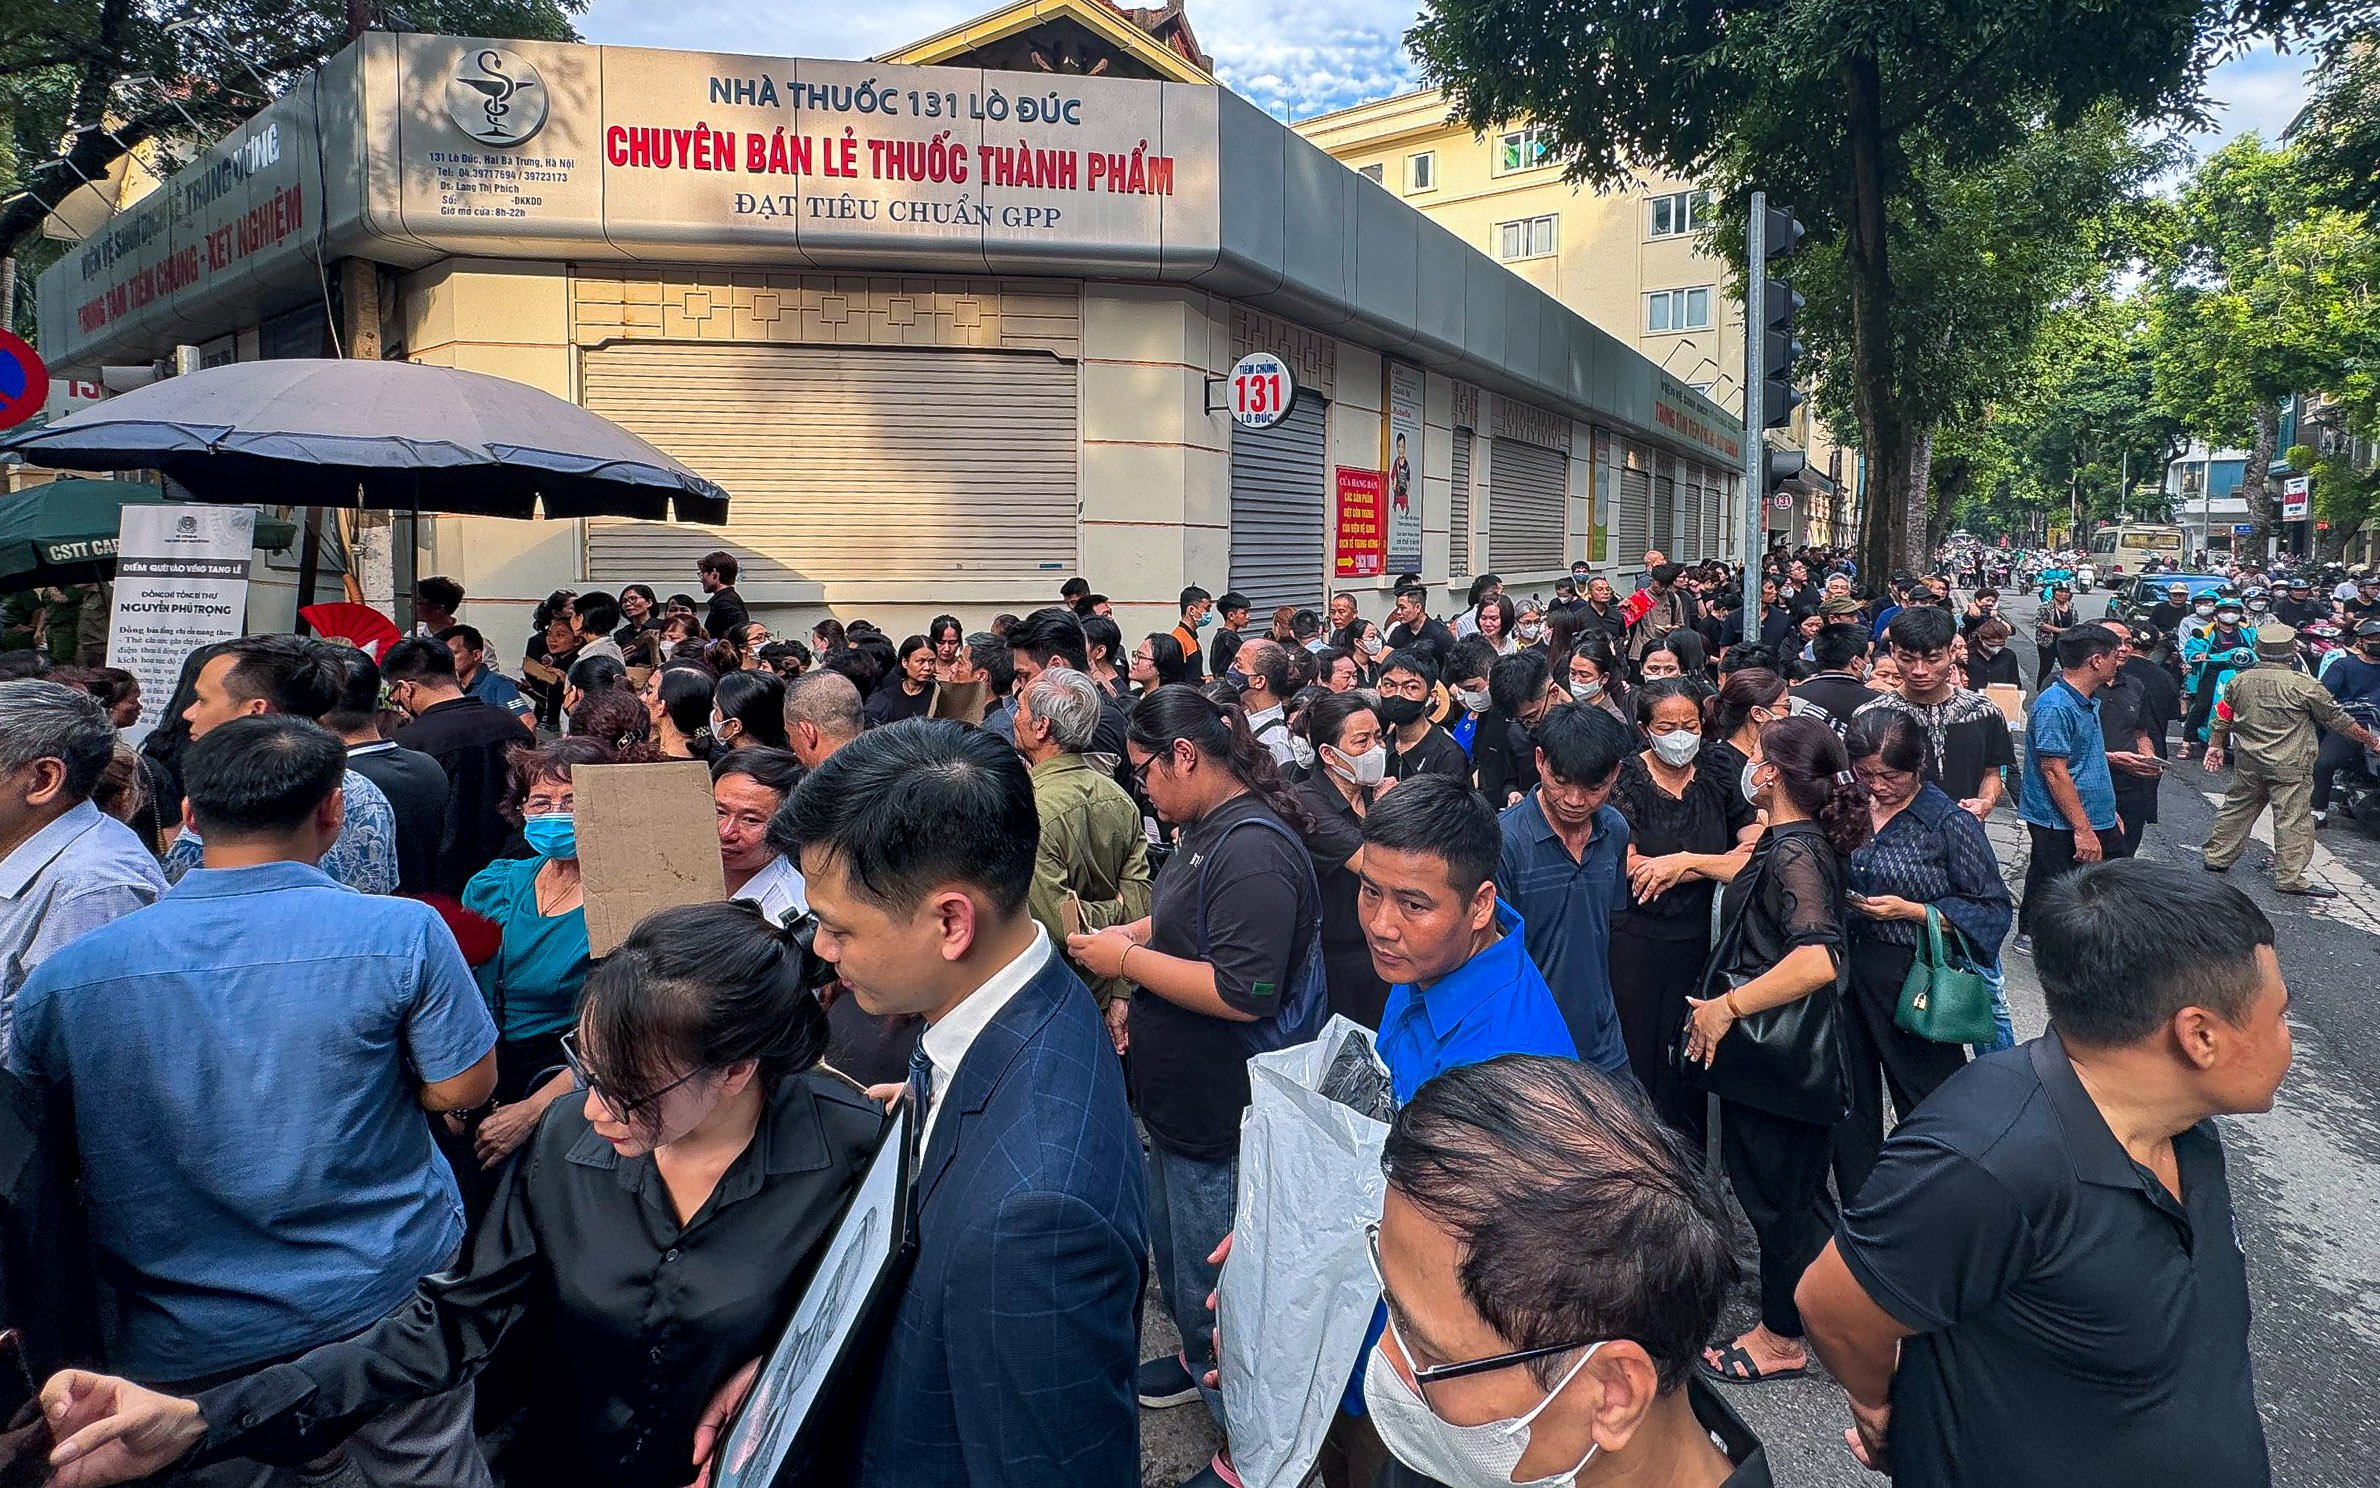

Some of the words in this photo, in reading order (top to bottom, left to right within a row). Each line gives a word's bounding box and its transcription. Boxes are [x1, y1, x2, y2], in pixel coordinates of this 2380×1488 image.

[709, 74, 780, 107] NHÀ
[787, 77, 899, 115] THUỐC
[908, 90, 957, 118] 131
[969, 88, 1009, 121] LÒ
[1016, 91, 1081, 125] ĐÚC
[429, 152, 445, 162] 131
[449, 153, 459, 162] Lò
[484, 155, 498, 165] Hai
[501, 156, 513, 165] Bà
[546, 158, 556, 167] Hà
[560, 159, 574, 170] Nội
[607, 121, 736, 172] CHUYÊN
[746, 126, 812, 175] BÁN
[824, 126, 858, 178] LẺ
[868, 130, 968, 184] THUỐC
[978, 139, 1077, 190] THÀNH
[1088, 138, 1174, 196] PHẨM
[459, 168, 516, 180] 04.39717694
[524, 171, 568, 182] 39723173
[479, 183, 492, 193] Thị
[735, 193, 797, 220] ĐẠT
[806, 193, 879, 220] TIÊU
[888, 193, 994, 228] CHUẨN
[1002, 206, 1062, 229] GPP
[204, 217, 233, 273] XÉT
[237, 183, 303, 258] NGHIỆM
[1235, 374, 1280, 412] 131
[1241, 411, 1252, 424] LÒ
[1255, 411, 1274, 424] ĐÚC
[1776, 497, 1791, 505] 131
[49, 541, 88, 560] CSTT
[123, 561, 147, 572] ĐIỂM
[208, 565, 231, 574] TANG
[194, 605, 232, 617] TRỌNG
